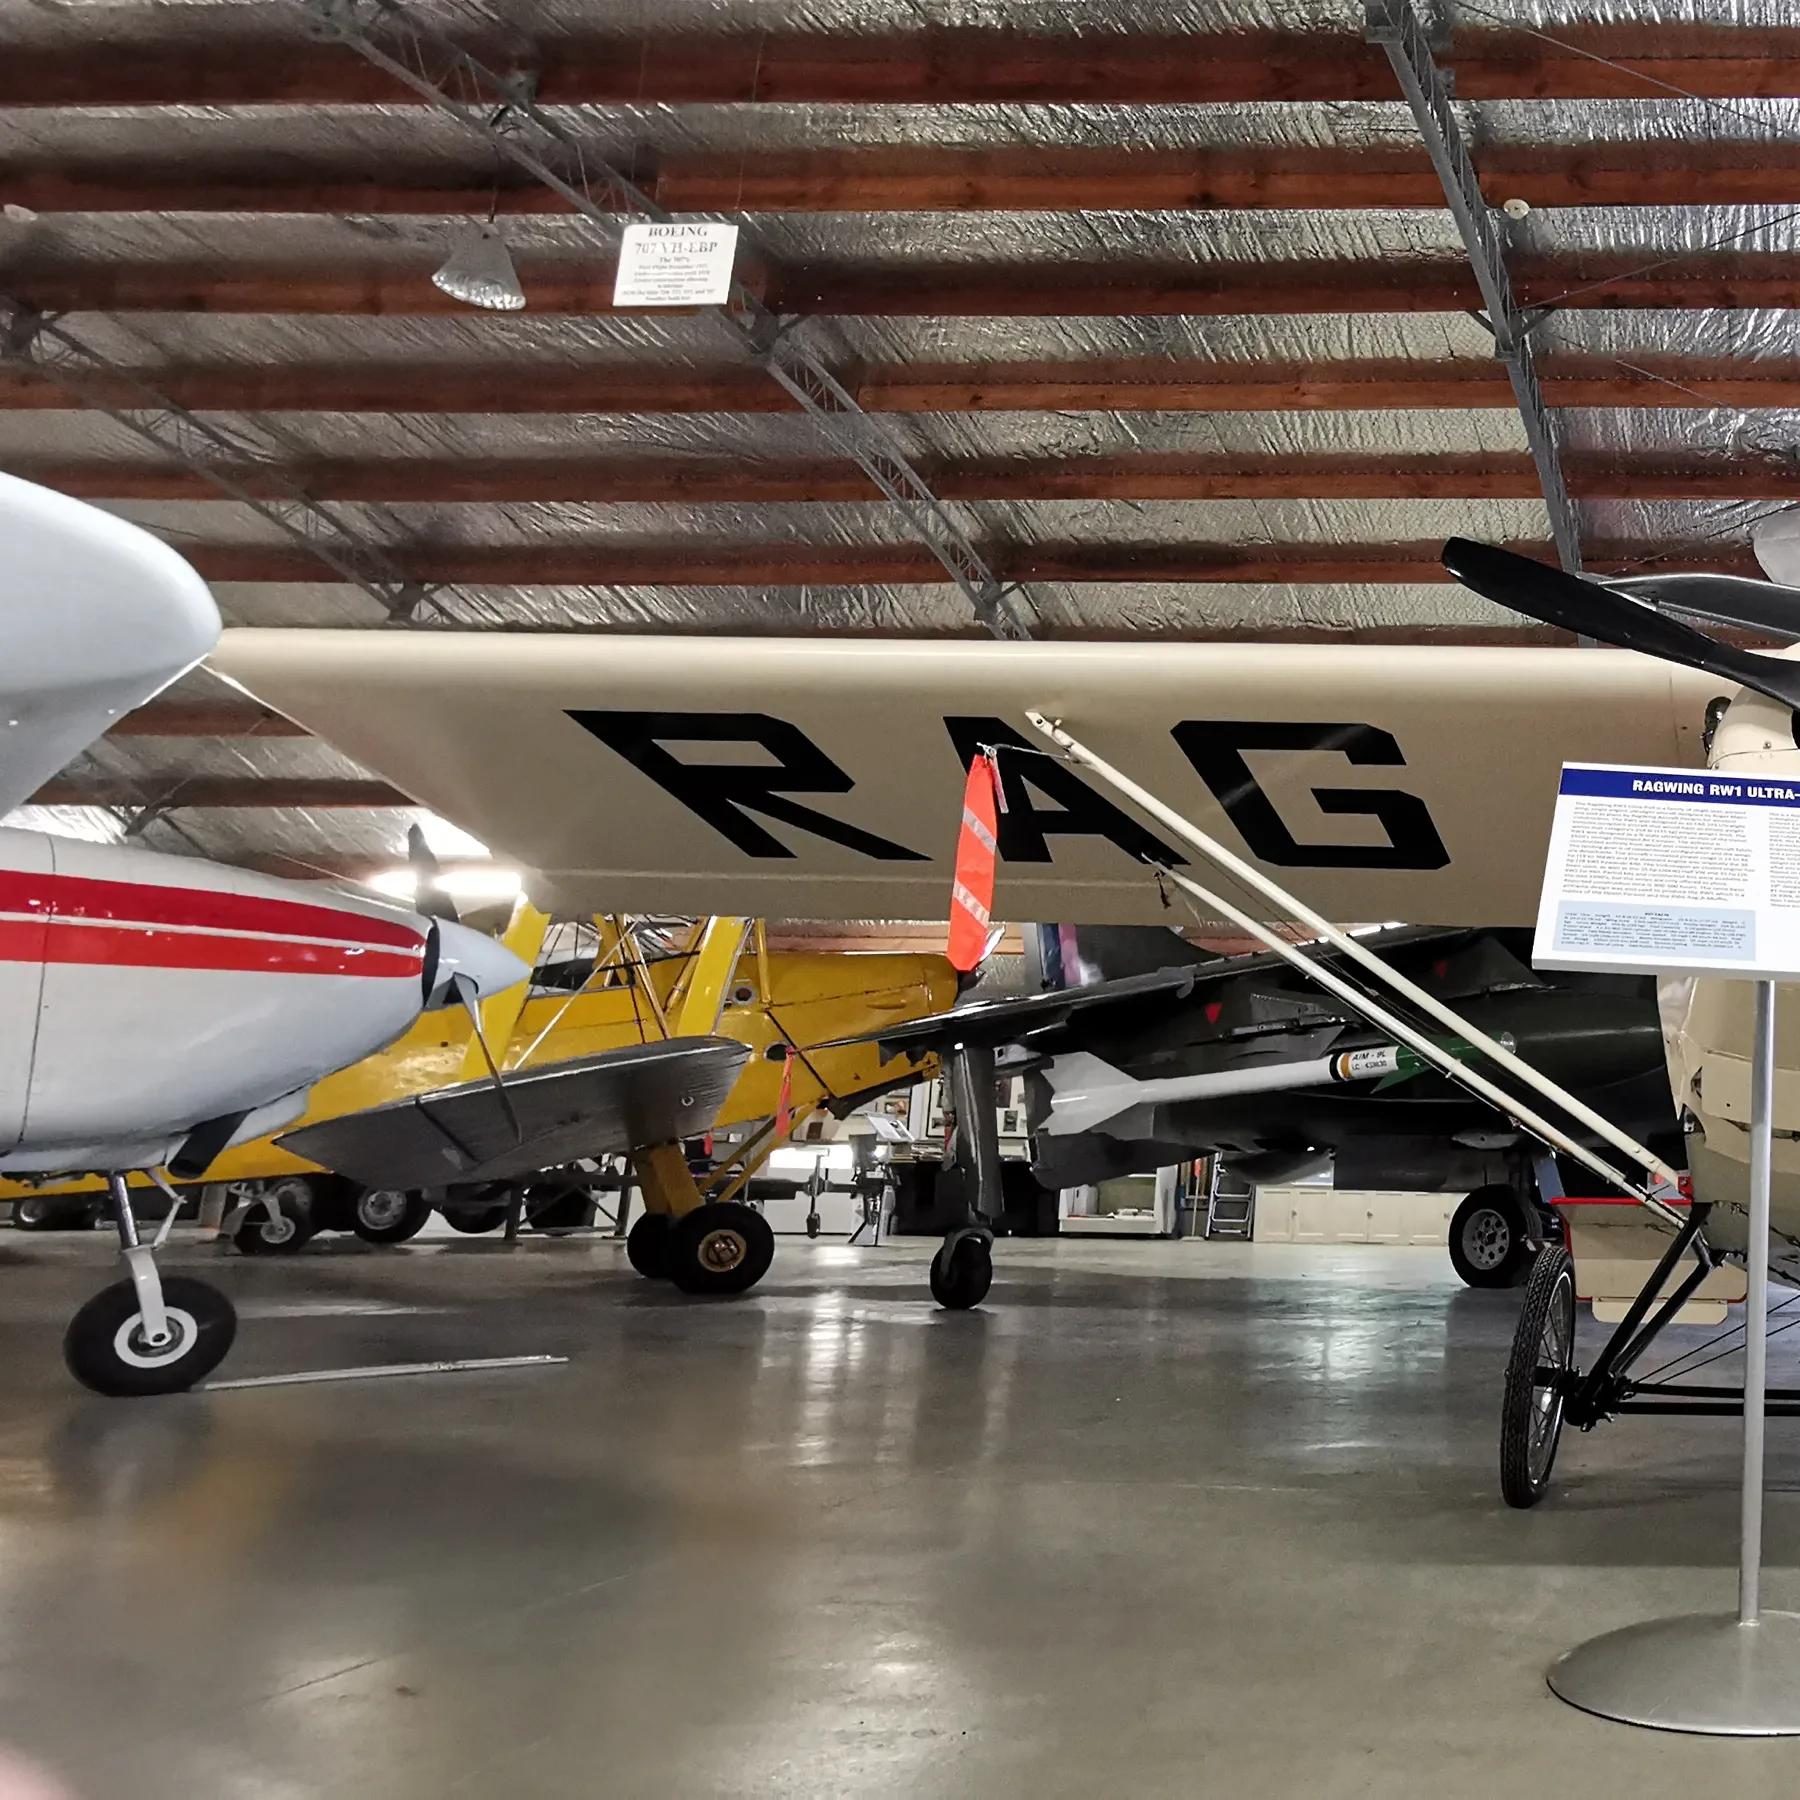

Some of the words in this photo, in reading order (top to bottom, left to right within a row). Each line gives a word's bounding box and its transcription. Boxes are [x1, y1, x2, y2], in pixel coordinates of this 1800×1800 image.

[648, 226, 708, 237] BOEING
[635, 243, 657, 255] 707
[562, 709, 1451, 870] RAG
[1632, 779, 1704, 795] RAGWING
[1709, 784, 1743, 797] RW1
